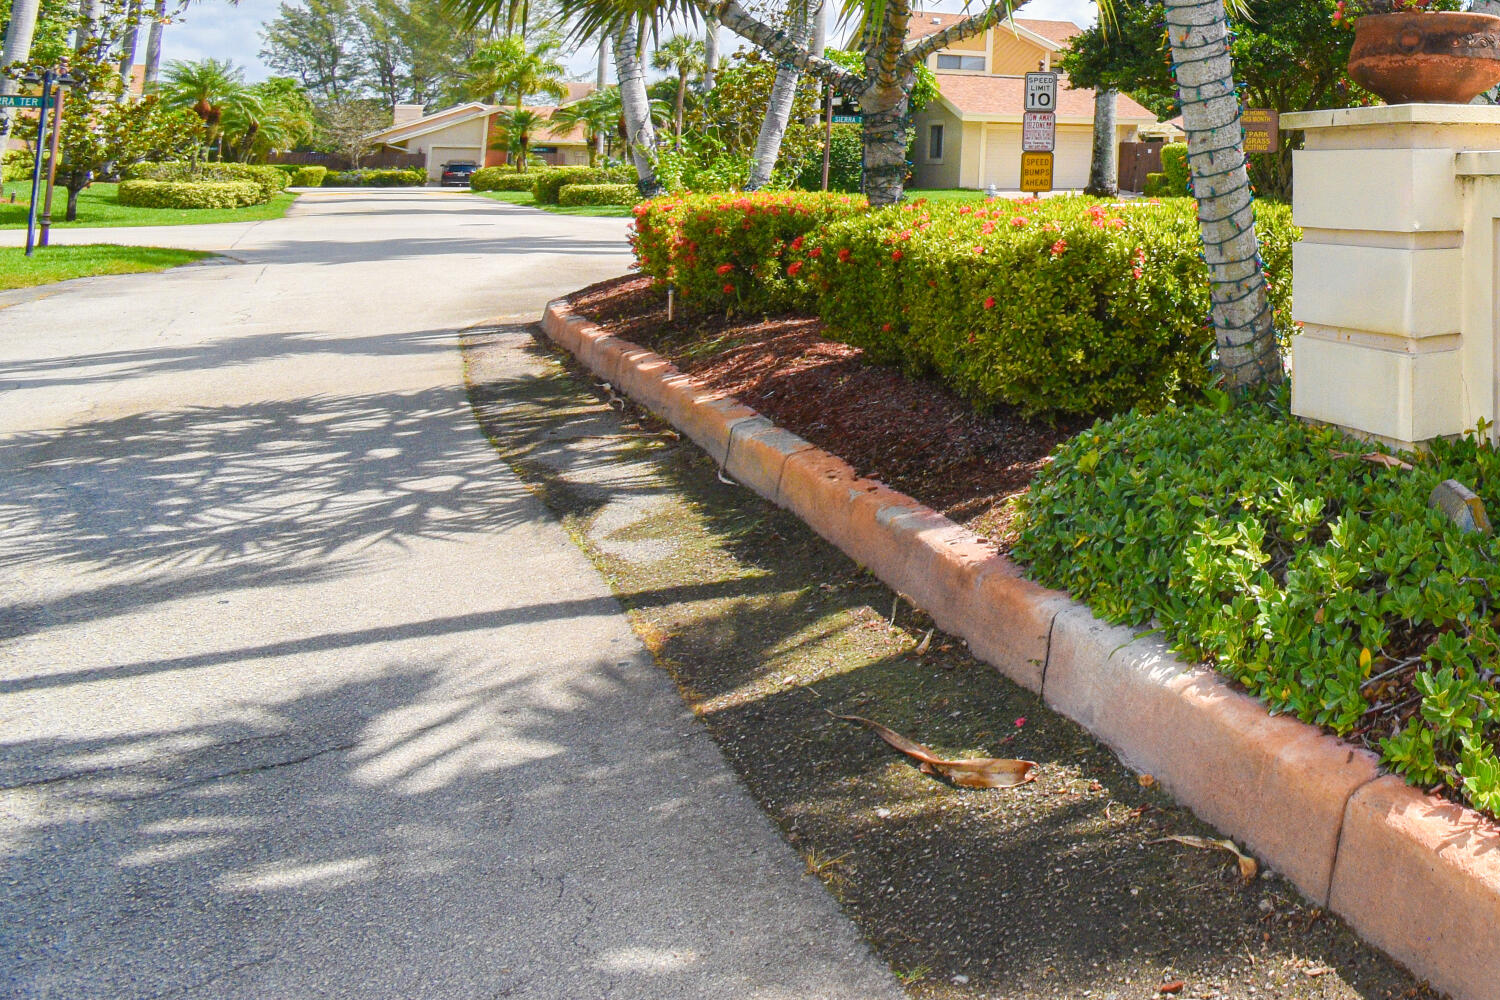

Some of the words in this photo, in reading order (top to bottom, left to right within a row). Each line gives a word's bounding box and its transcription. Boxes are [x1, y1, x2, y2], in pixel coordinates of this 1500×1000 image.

[20, 98, 39, 106] TER
[1030, 92, 1051, 106] 10
[834, 115, 856, 123] SIERRA
[1246, 137, 1271, 145] GRASS
[1026, 158, 1049, 166] SPEED
[1024, 168, 1050, 176] BUMPS
[1025, 178, 1049, 187] AHEAD
